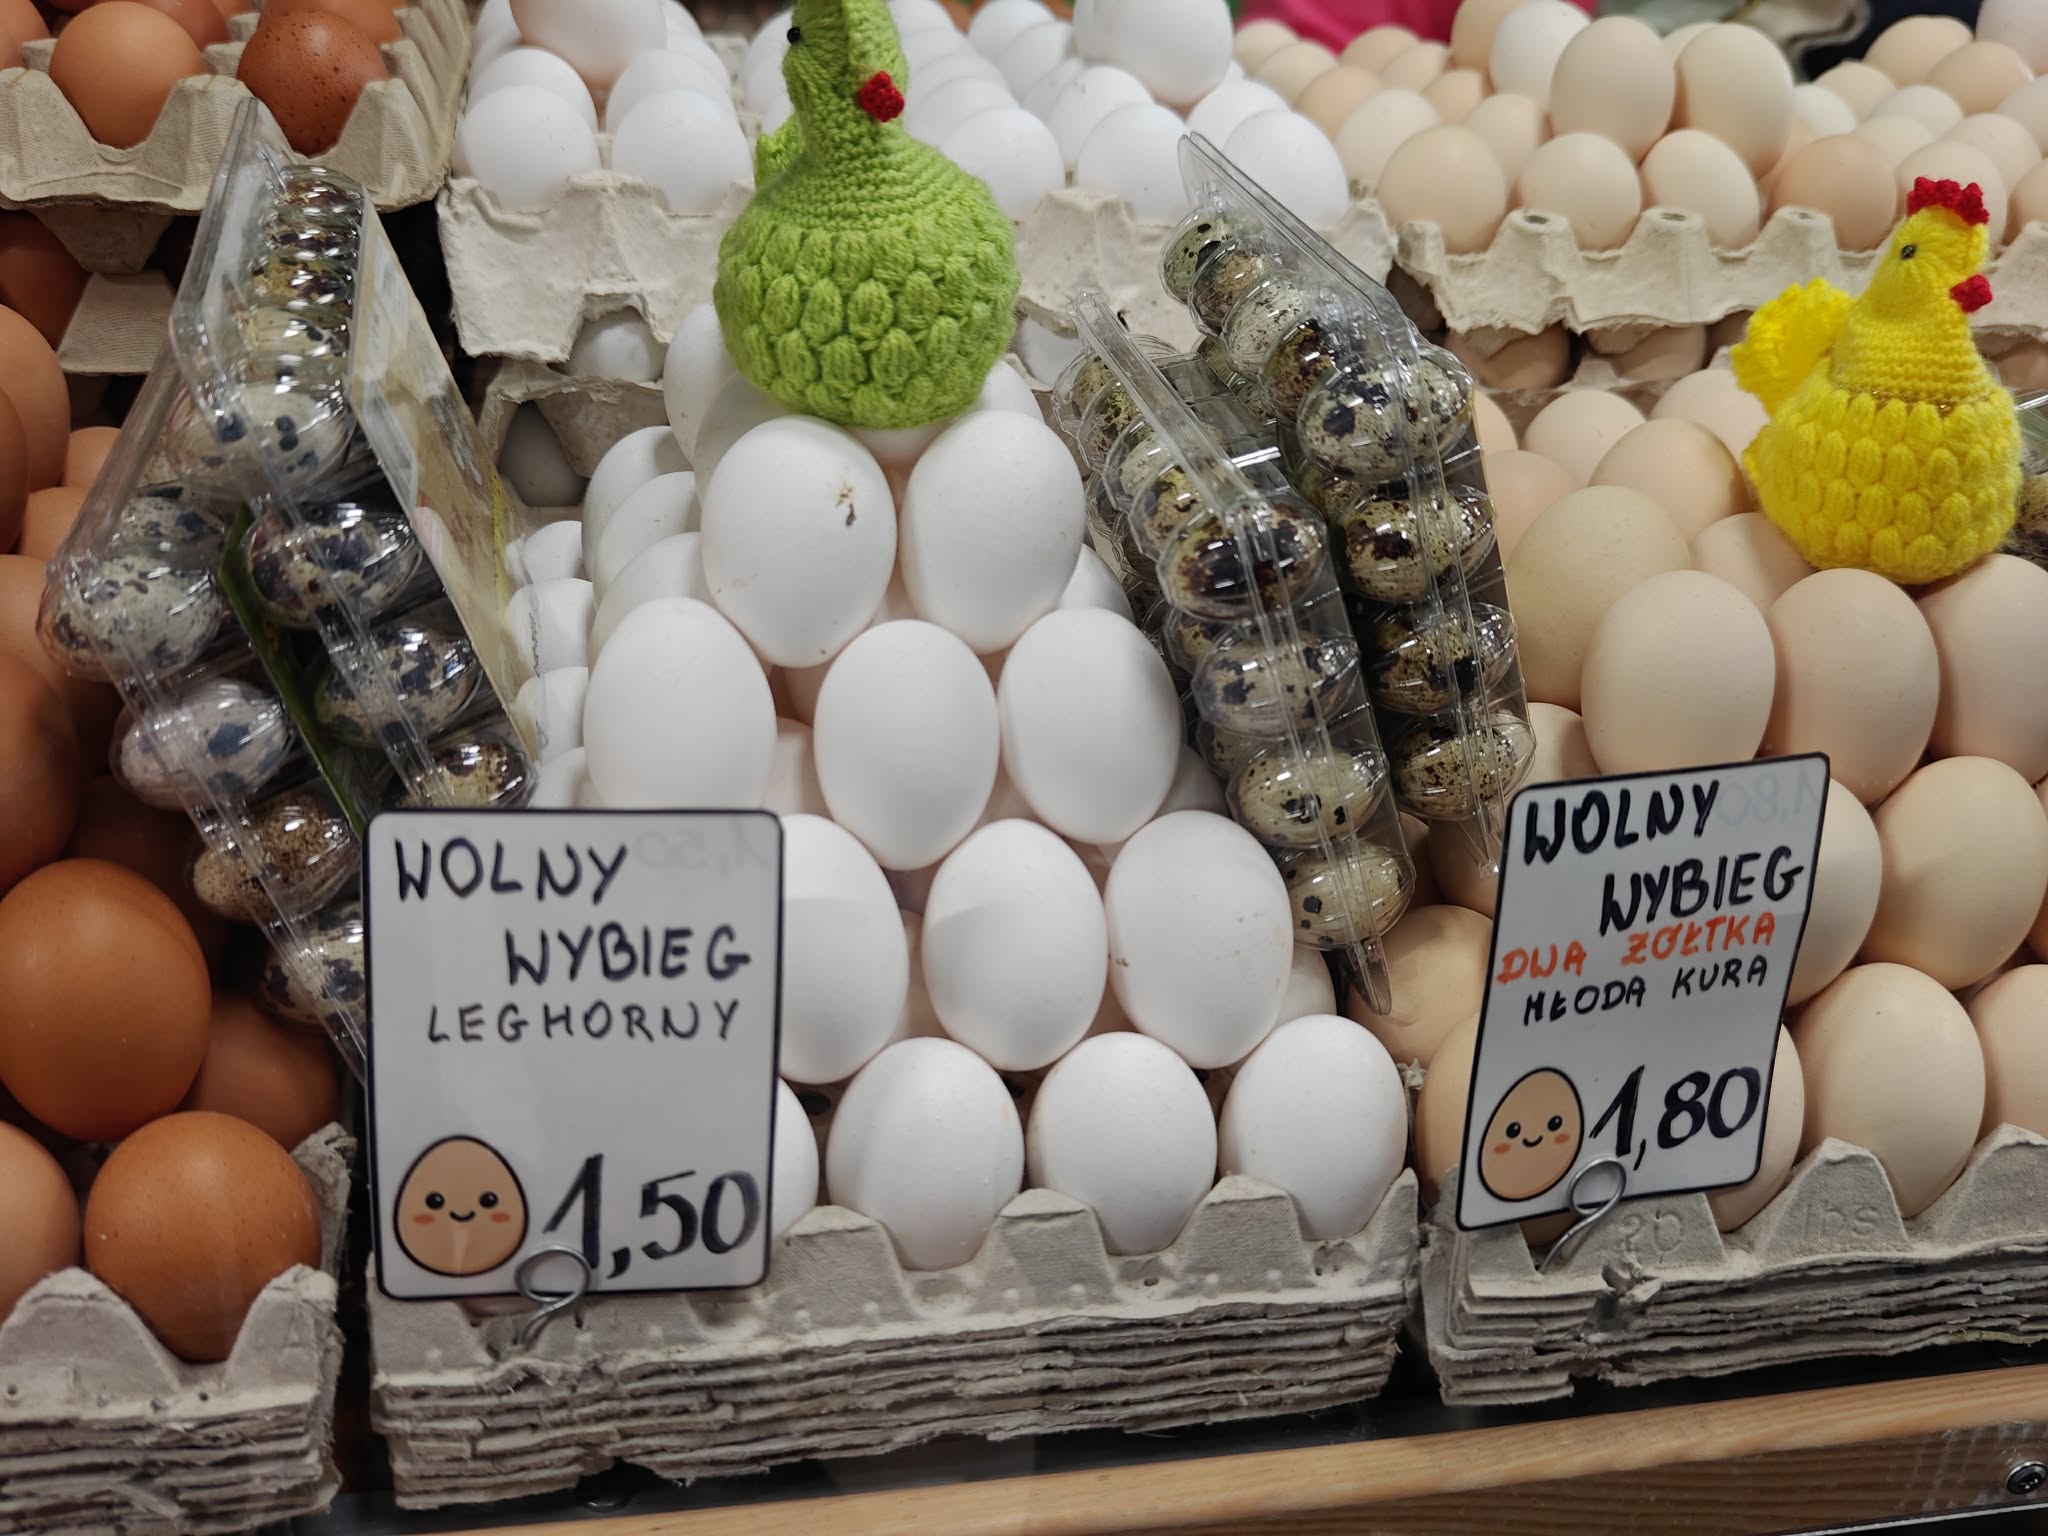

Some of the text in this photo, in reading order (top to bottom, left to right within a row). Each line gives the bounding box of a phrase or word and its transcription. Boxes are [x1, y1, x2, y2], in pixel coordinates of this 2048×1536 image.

[1523, 779, 1720, 867] WOLNY
[394, 836, 628, 906] WOLNY
[1600, 846, 1804, 937] WYBIEG
[504, 920, 752, 987] WYBIEG
[1496, 940, 1588, 984] DWA
[1671, 954, 1768, 1000] KURA
[427, 998, 740, 1044] LEGHORNY
[1589, 1064, 1762, 1172] 1,80
[543, 1152, 761, 1281] 1,50
